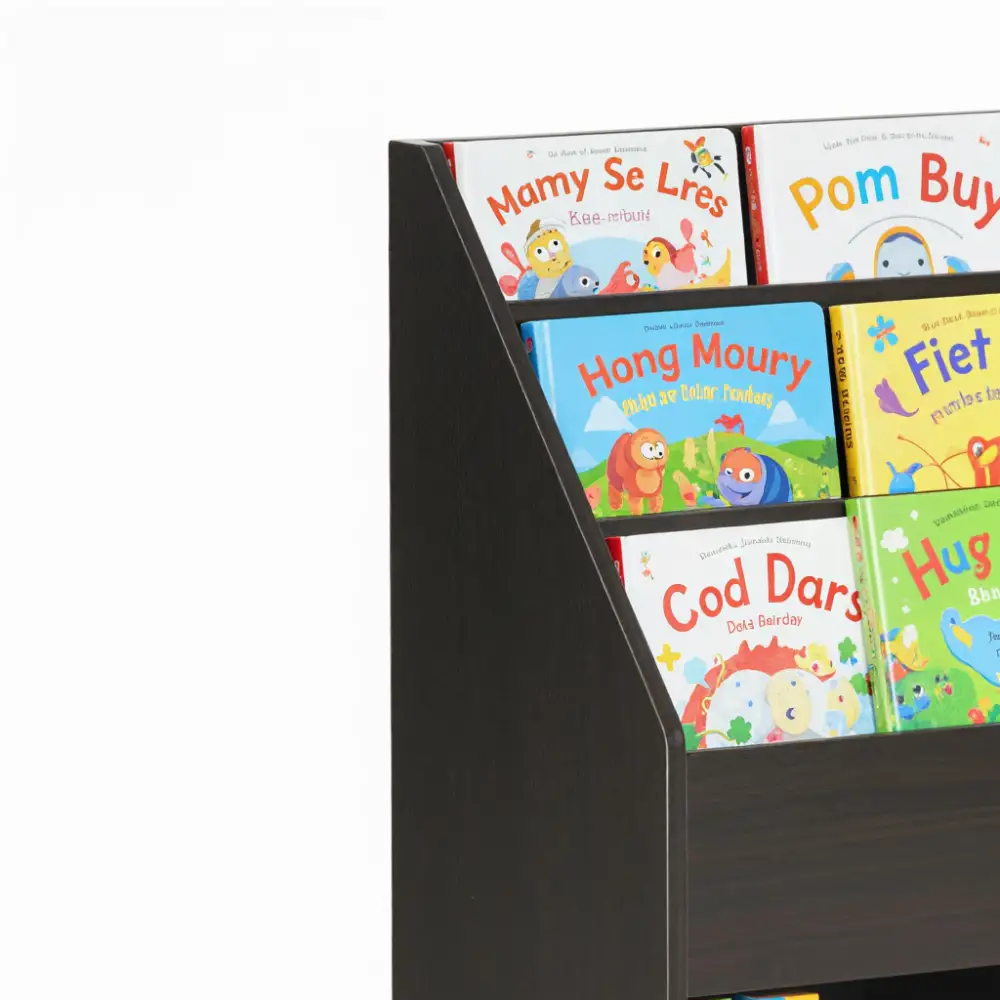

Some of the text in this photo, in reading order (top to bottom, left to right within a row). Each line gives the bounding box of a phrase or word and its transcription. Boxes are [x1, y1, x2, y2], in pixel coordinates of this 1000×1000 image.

[486, 168, 590, 226] Mamy
[603, 156, 646, 191] Se
[656, 161, 729, 218] Lres
[788, 165, 900, 231] Pom
[577, 343, 681, 398] Hong
[691, 332, 813, 393] Moury
[903, 327, 992, 396] Fiet
[662, 552, 863, 633] Cod Dars
[901, 532, 993, 601] Hug
